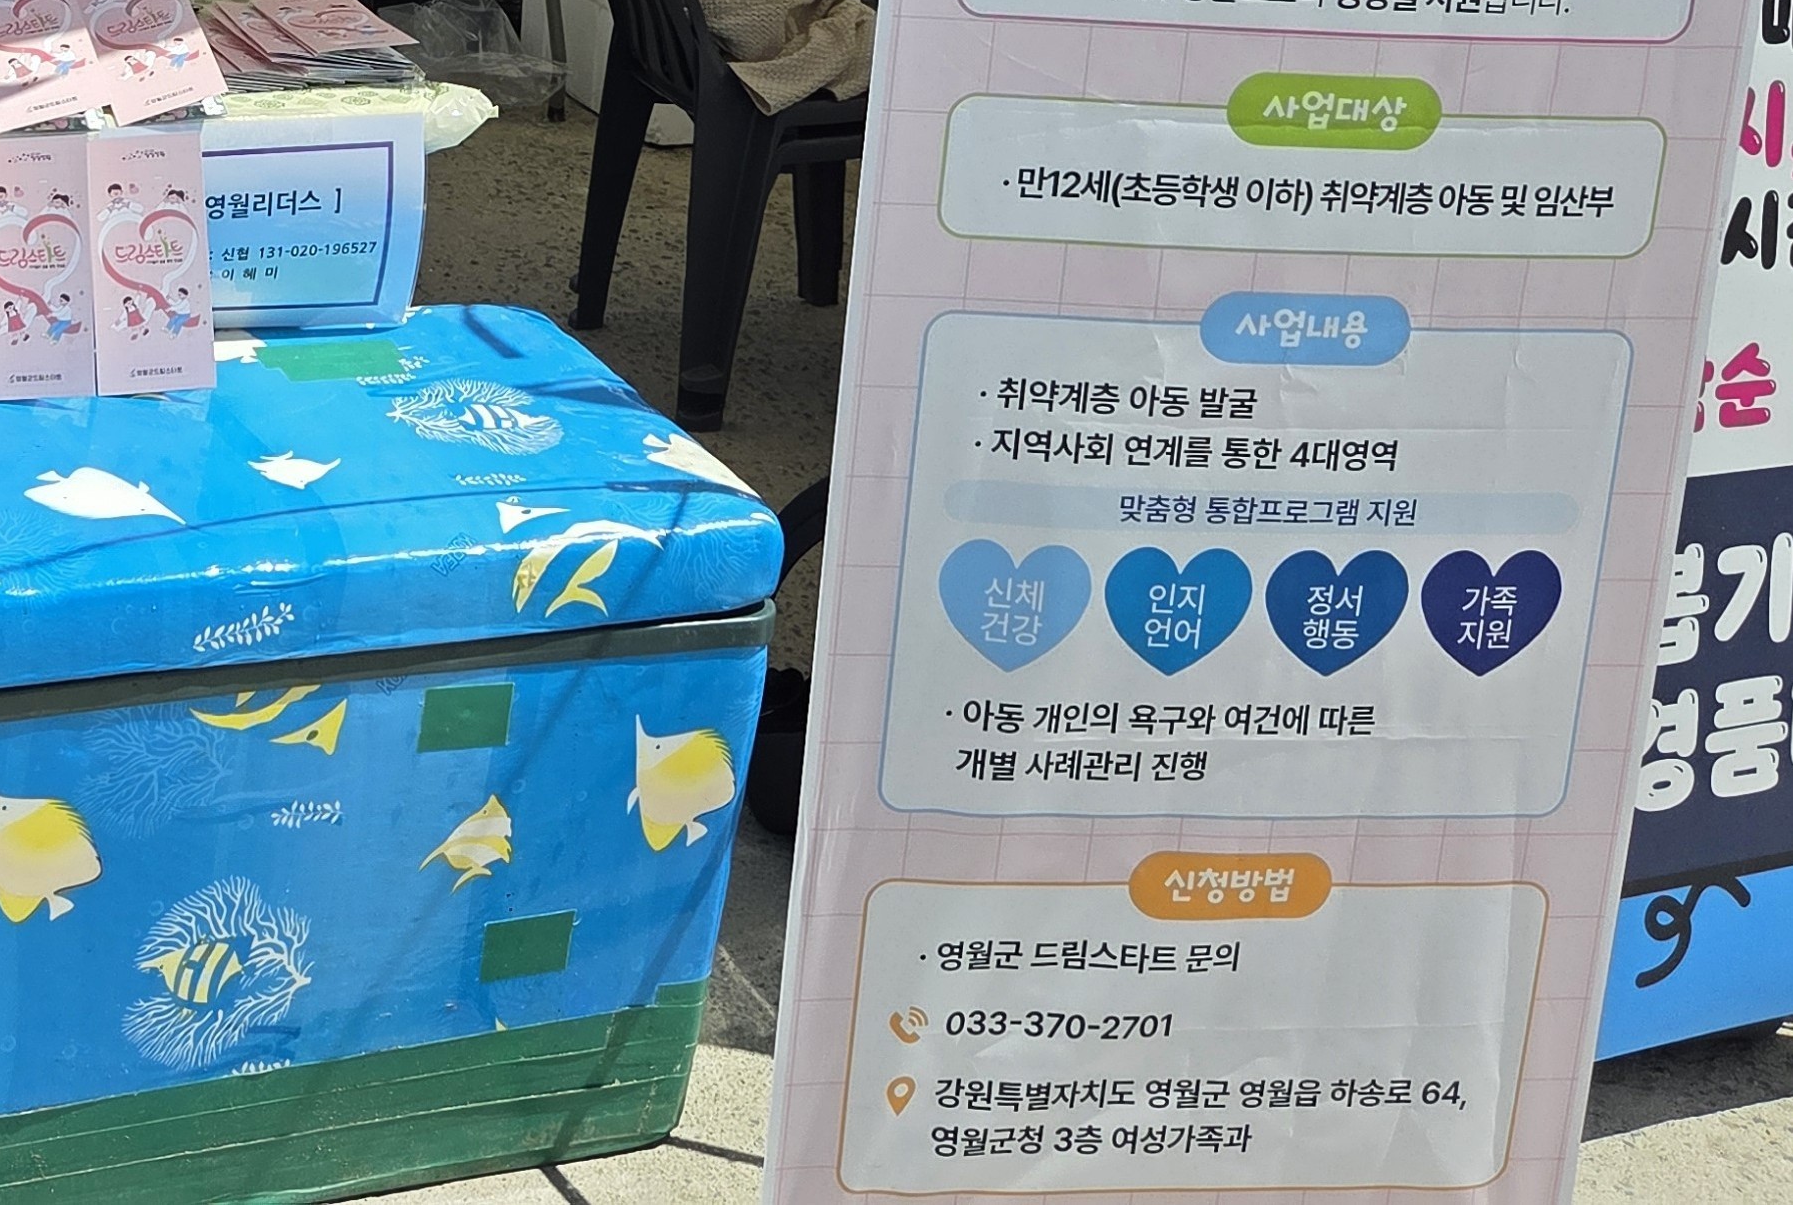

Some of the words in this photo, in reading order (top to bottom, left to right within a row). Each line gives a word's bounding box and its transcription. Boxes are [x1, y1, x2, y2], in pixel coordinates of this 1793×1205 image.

[1263, 90, 1408, 134] 사업대상
[205, 189, 322, 220] 영월리더스
[1015, 166, 1240, 212] 만12세(초등학생
[1244, 174, 1315, 217] 이하)
[1319, 176, 1434, 217] 취약계층
[1438, 180, 1495, 218] 아동
[1500, 183, 1526, 218] 및
[1532, 184, 1615, 222] 임산부
[221, 246, 250, 262] 신협
[259, 241, 378, 260] 131-020-196527
[221, 268, 235, 282] 이
[265, 266, 279, 280] 미
[1234, 308, 1370, 351] 사업내용
[996, 377, 1121, 419] 취약계층
[1128, 383, 1191, 420] 아동
[1198, 386, 1259, 422] 발굴
[989, 428, 1115, 469] 지역사회
[1124, 434, 1214, 471] 연계를
[1220, 436, 1283, 474] 통한
[1289, 438, 1399, 476] 4대영역
[1118, 493, 1197, 527] 맞춤형
[1204, 495, 1361, 530] 통합프로그램
[1366, 496, 1419, 529] 지원
[984, 579, 1047, 615] 신체
[1147, 583, 1207, 616] 인지
[1306, 584, 1365, 618] 정서
[1461, 584, 1519, 618] 가족
[979, 613, 1043, 649] 건강
[1143, 617, 1204, 652] 언어
[1302, 618, 1361, 652] 행동
[1457, 618, 1514, 652] 지원
[962, 699, 1025, 736] 아동
[1032, 701, 1121, 737] 개인의
[1126, 702, 1217, 738] 욕구와
[1223, 703, 1311, 738] 여건에
[1317, 703, 1377, 738] 따른
[954, 748, 1018, 784] 개별
[1024, 749, 1143, 784] 사례관리
[1150, 750, 1210, 784] 진행
[1162, 867, 1298, 906] 신청방법
[935, 940, 1024, 977] 영월군
[1030, 940, 1180, 977] 드림스타트
[1183, 942, 1242, 976] 문의
[944, 1009, 1175, 1043] 033-370-2701
[933, 1078, 1138, 1114] 강원특별자치도
[1143, 1077, 1232, 1112] 영월군
[1237, 1077, 1323, 1112] 영월읍
[1328, 1076, 1414, 1111] 하송로
[1420, 1079, 1469, 1113] 64,
[929, 1124, 1045, 1160] 영월군청
[1052, 1125, 1105, 1158] 3층
[1110, 1124, 1254, 1159] 여성가족과
